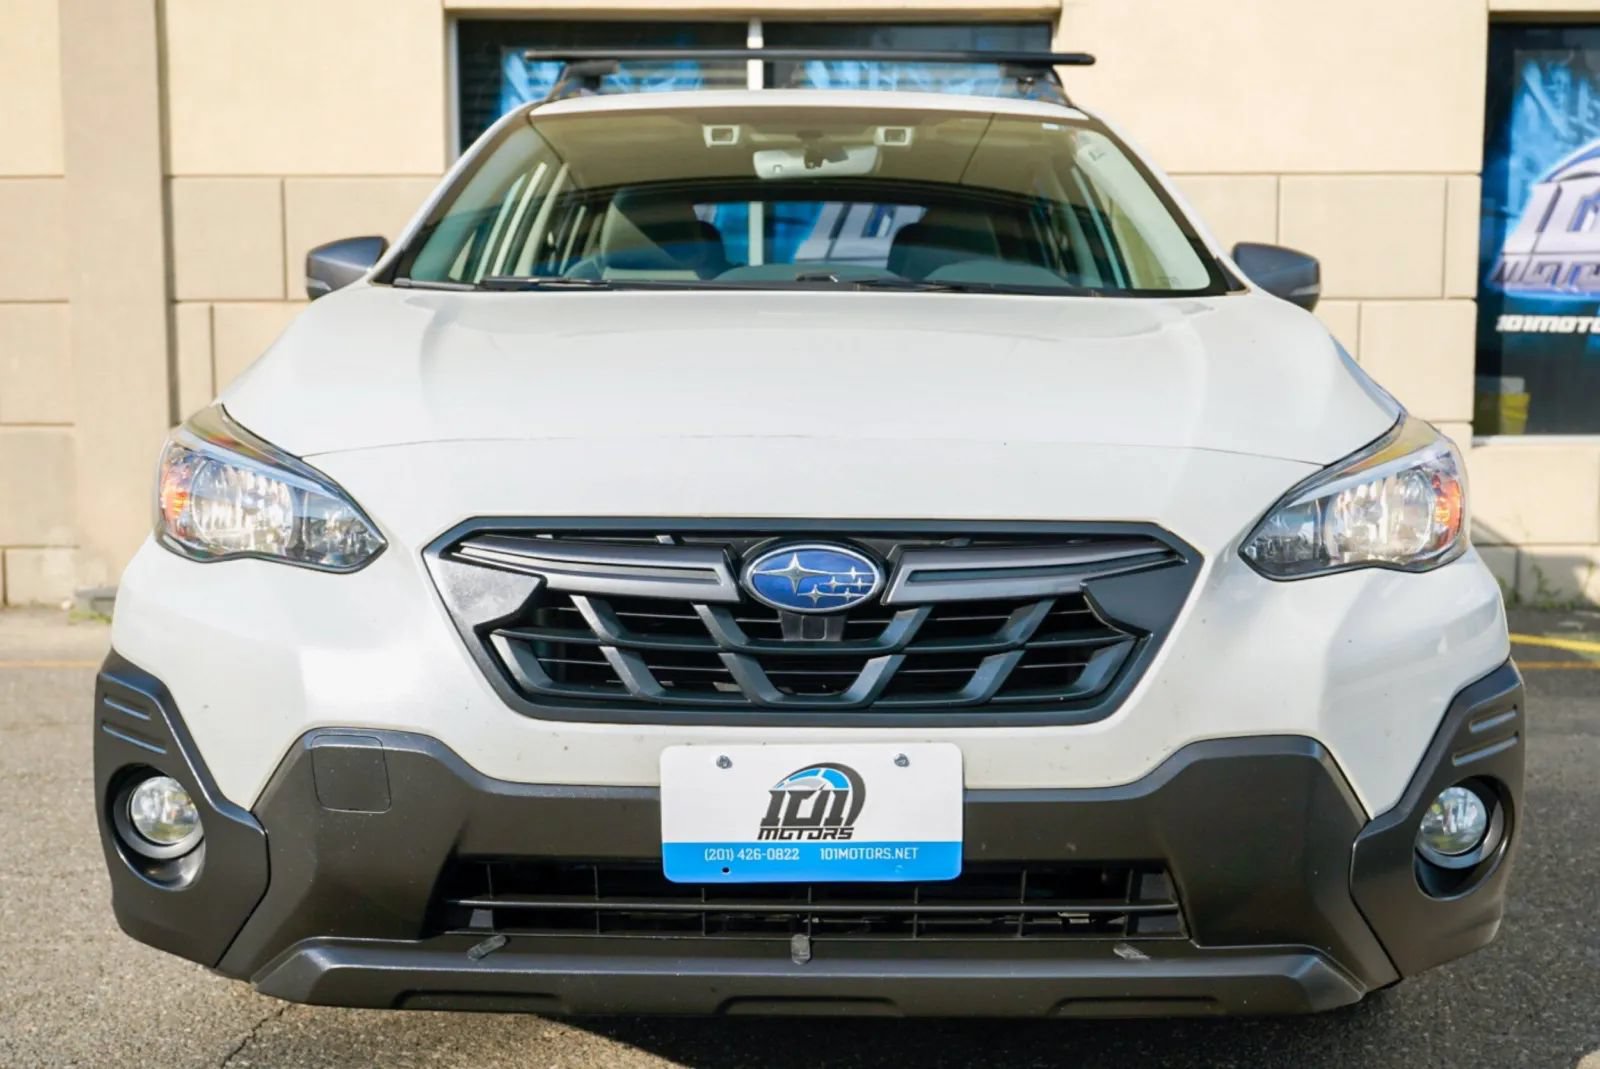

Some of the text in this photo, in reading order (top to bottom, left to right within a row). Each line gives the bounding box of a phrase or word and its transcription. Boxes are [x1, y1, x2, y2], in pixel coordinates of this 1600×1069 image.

[760, 789, 850, 827] 101
[757, 827, 854, 840] MOTORS
[704, 846, 920, 861] (201) 426-0822 101MOTORS.NET
